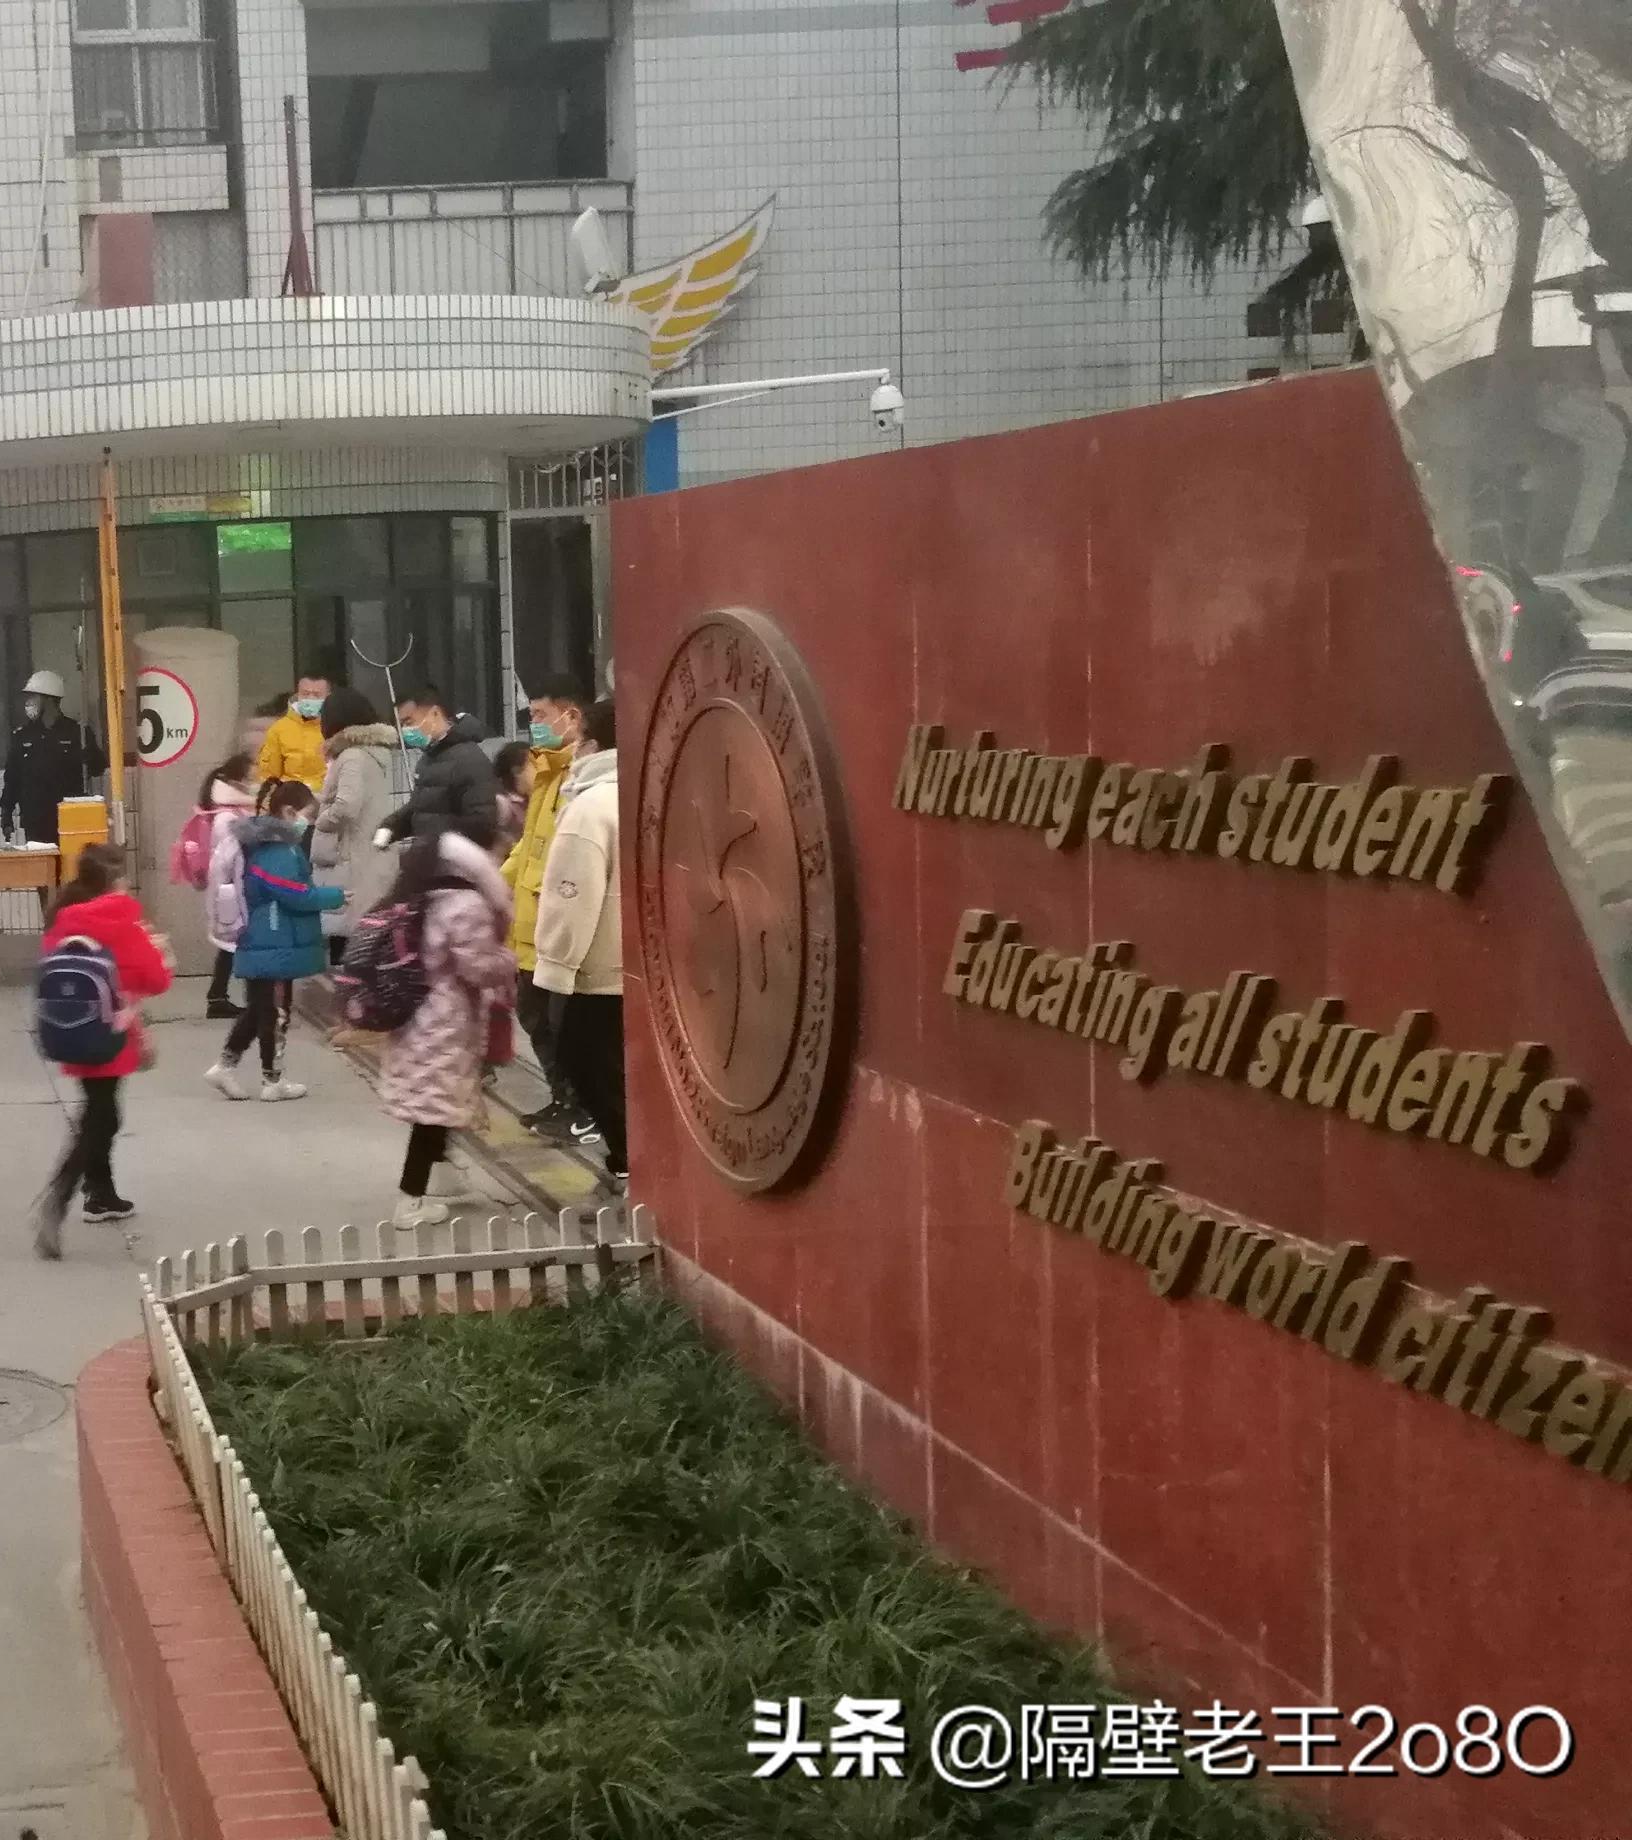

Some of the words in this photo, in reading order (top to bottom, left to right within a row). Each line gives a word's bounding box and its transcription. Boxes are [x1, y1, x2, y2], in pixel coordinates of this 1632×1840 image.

[136, 685, 164, 755] 5
[167, 728, 188, 739] km
[893, 725, 1100, 850] Nurturing
[1088, 743, 1228, 851] each
[1218, 754, 1508, 893] student
[942, 908, 1180, 1081] Educating
[1167, 970, 1275, 1078] all
[1248, 997, 1583, 1169] students
[1009, 1118, 1213, 1298] Building
[1197, 1219, 1410, 1361] world
[1376, 1285, 1632, 1485] citizen
